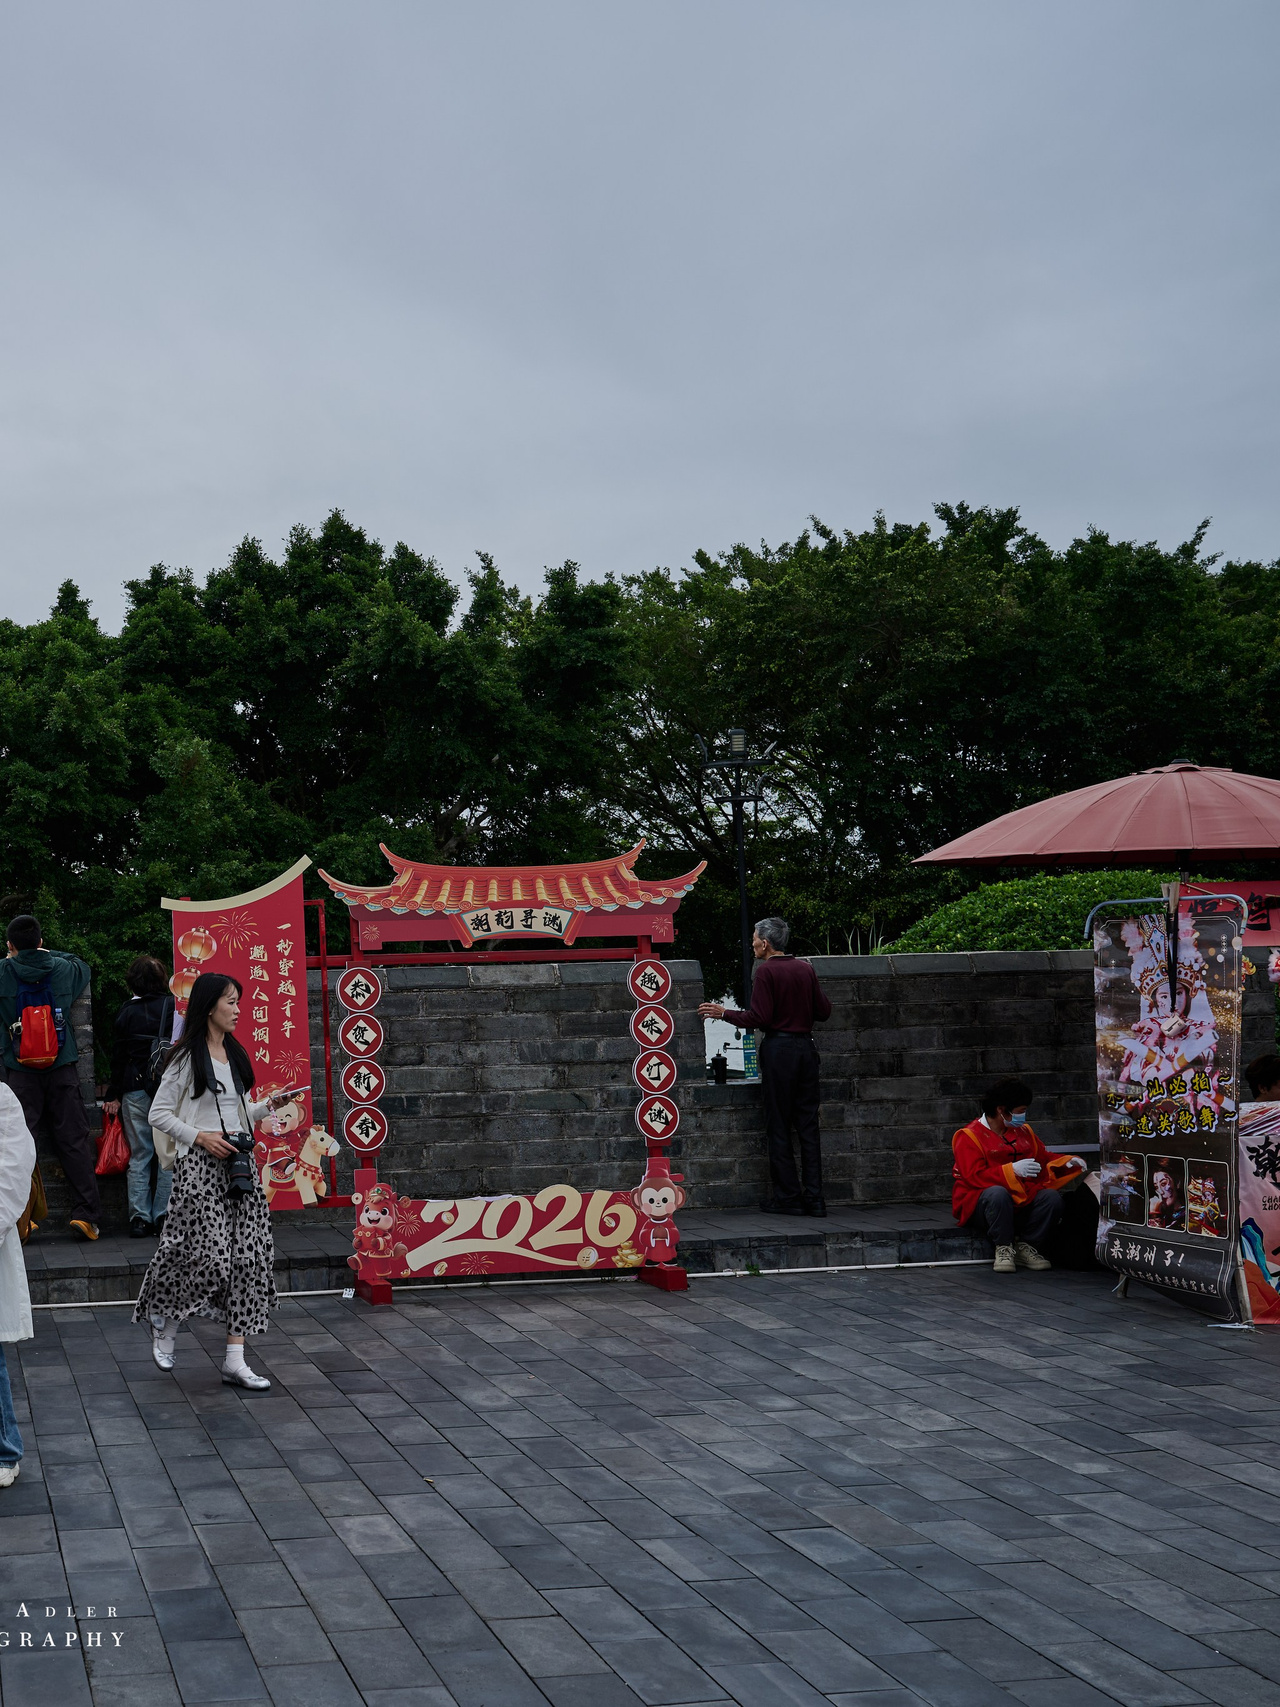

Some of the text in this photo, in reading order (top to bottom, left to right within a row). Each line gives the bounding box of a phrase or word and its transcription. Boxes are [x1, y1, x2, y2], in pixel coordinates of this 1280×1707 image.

[249, 944, 270, 1064] 邂逅人间烟火
[276, 923, 297, 1039] 一秒穿越千年
[350, 979, 378, 1139] 恭贺新春
[640, 971, 670, 1126] 趣味灯谜
[406, 1184, 637, 1271] 2026
[1262, 1195, 1280, 1203] CHA
[1262, 1203, 1280, 1211] ZHO
